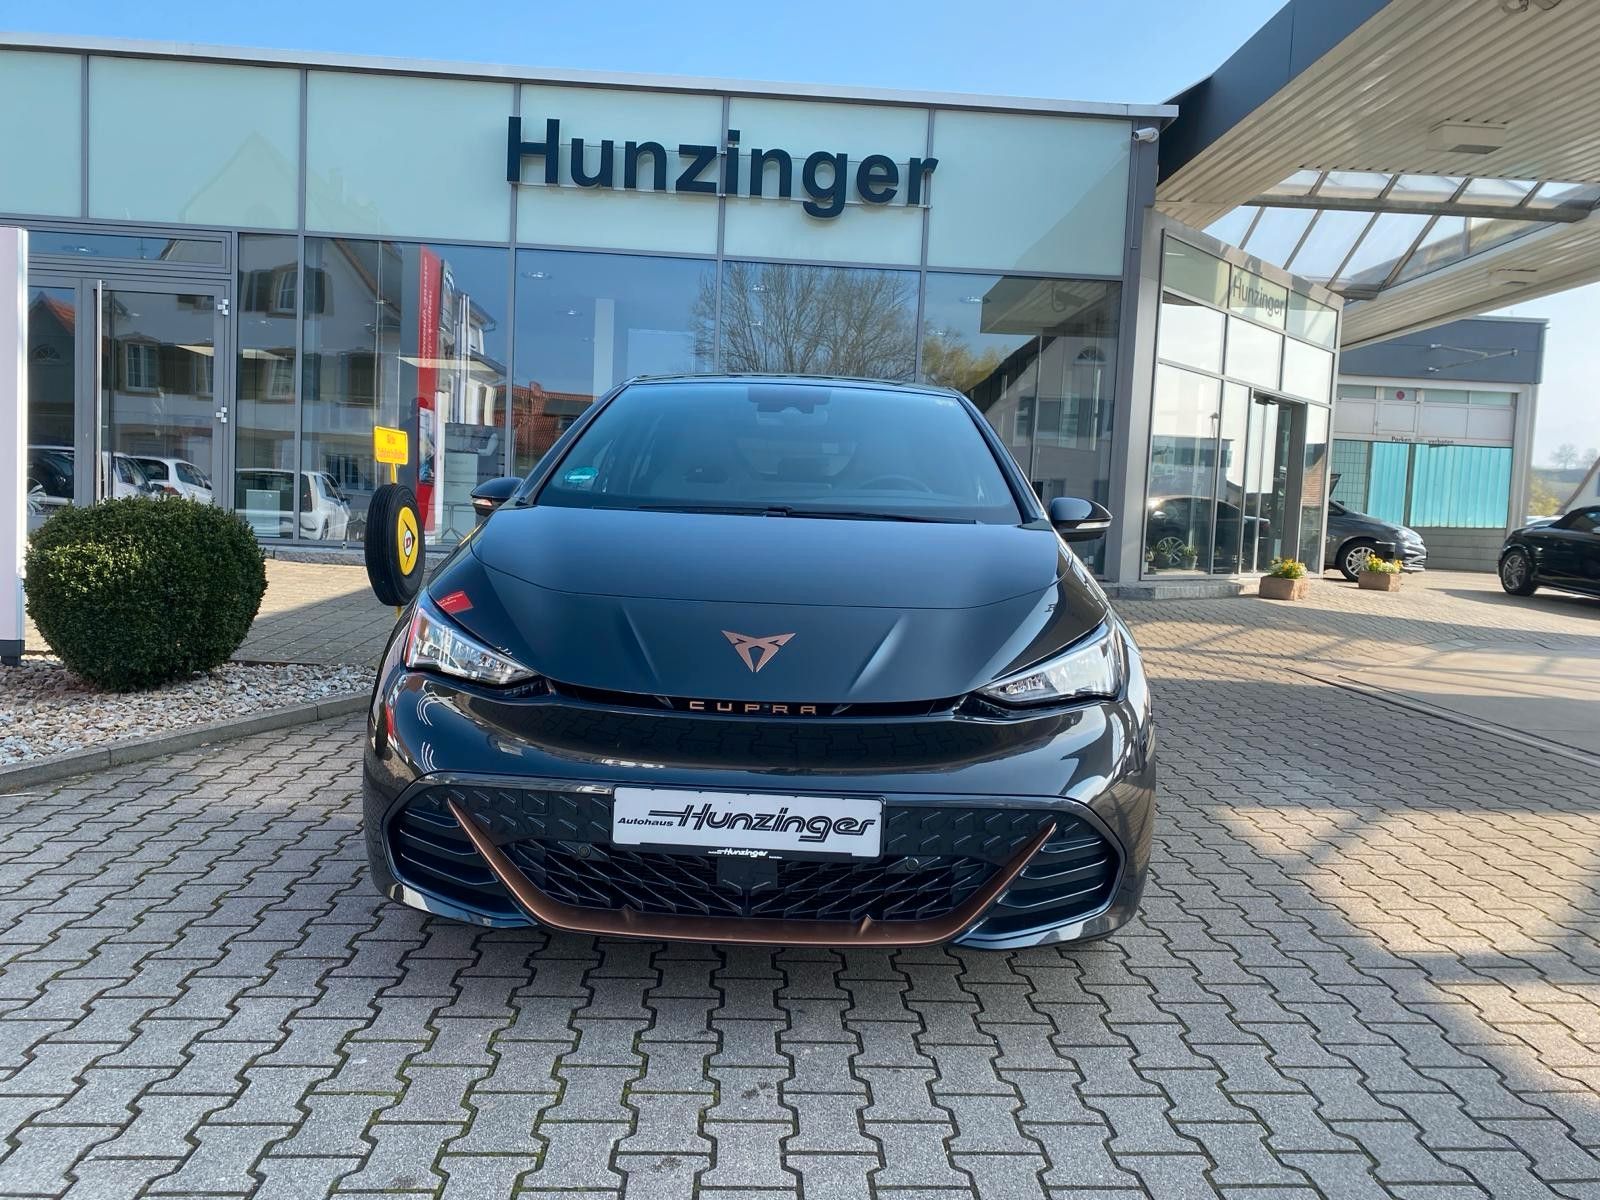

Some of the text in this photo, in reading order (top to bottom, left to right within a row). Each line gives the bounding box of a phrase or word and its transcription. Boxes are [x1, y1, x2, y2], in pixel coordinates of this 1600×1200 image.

[507, 116, 939, 219] Hunzinger
[1233, 275, 1284, 317] Hunzinger
[405, 538, 412, 549] D
[689, 700, 817, 715] CUPRA
[617, 803, 876, 843] Autohaus Hunzinger
[717, 848, 768, 858] Hunzinger
